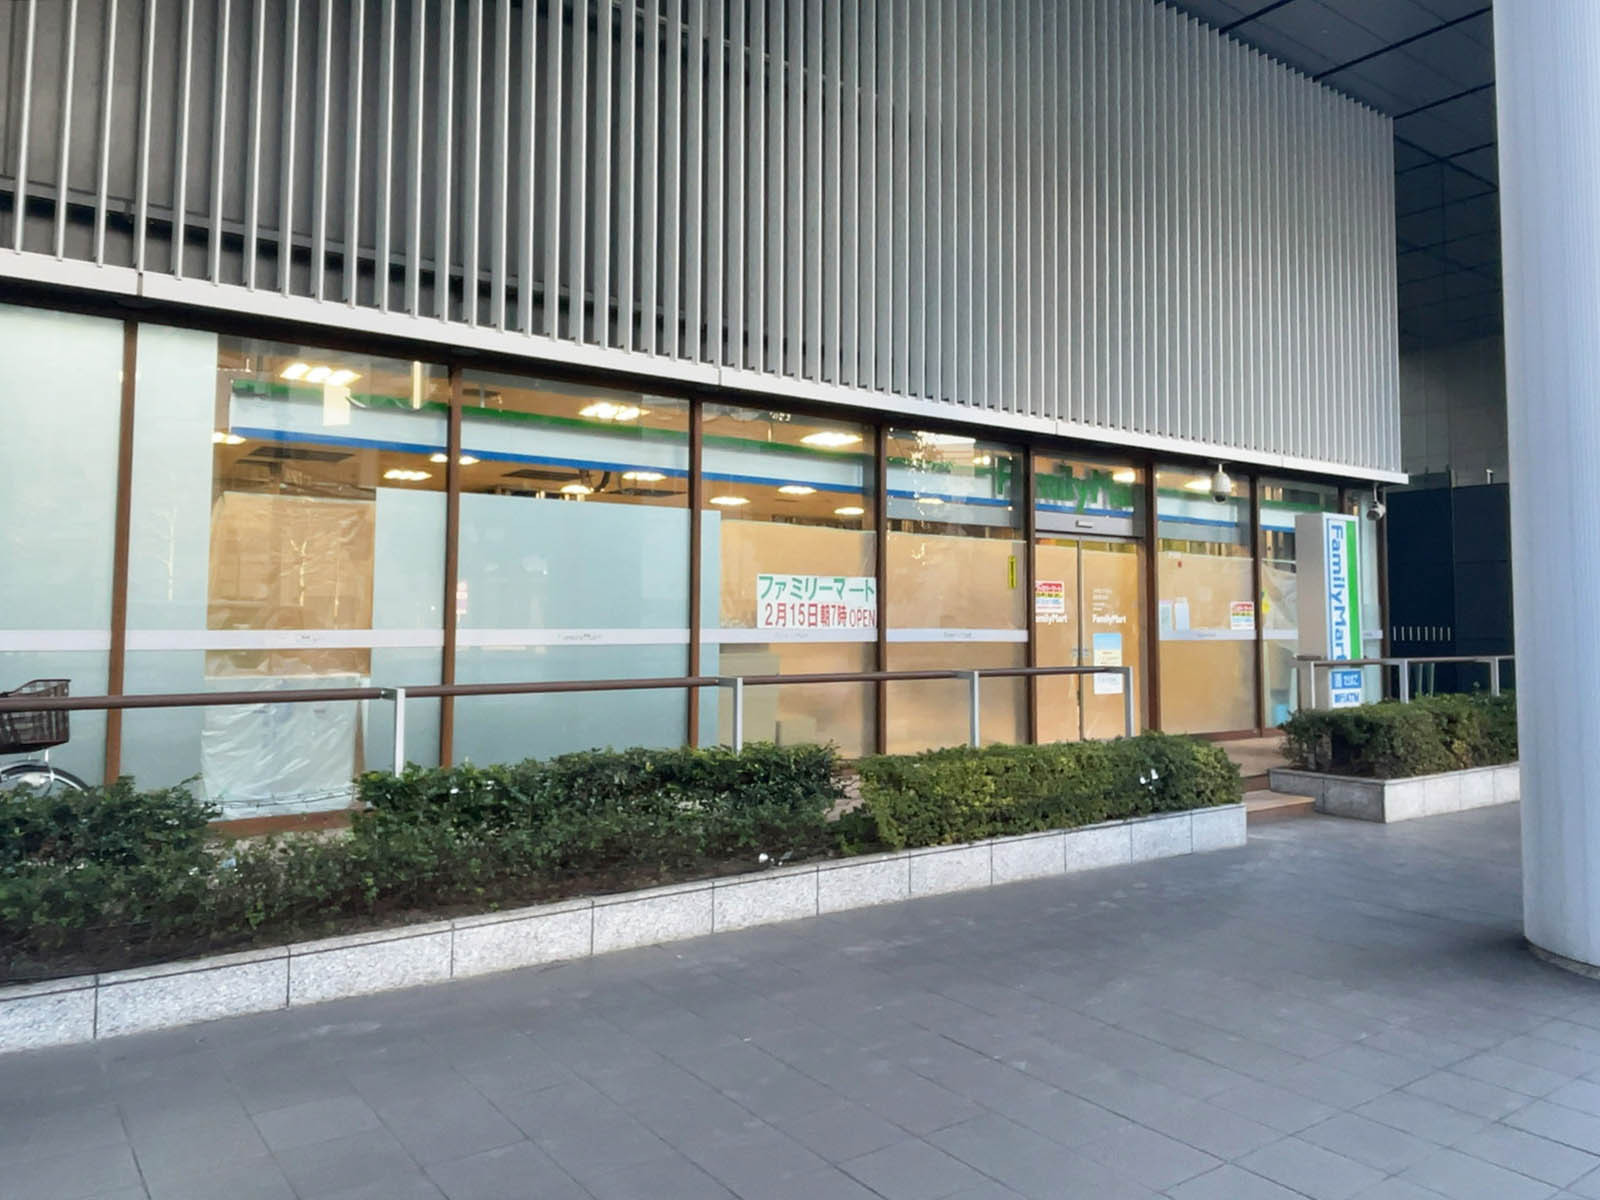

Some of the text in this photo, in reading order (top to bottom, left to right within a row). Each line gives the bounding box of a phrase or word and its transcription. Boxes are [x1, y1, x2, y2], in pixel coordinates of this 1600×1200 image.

[759, 575, 875, 602] ファミリーマート
